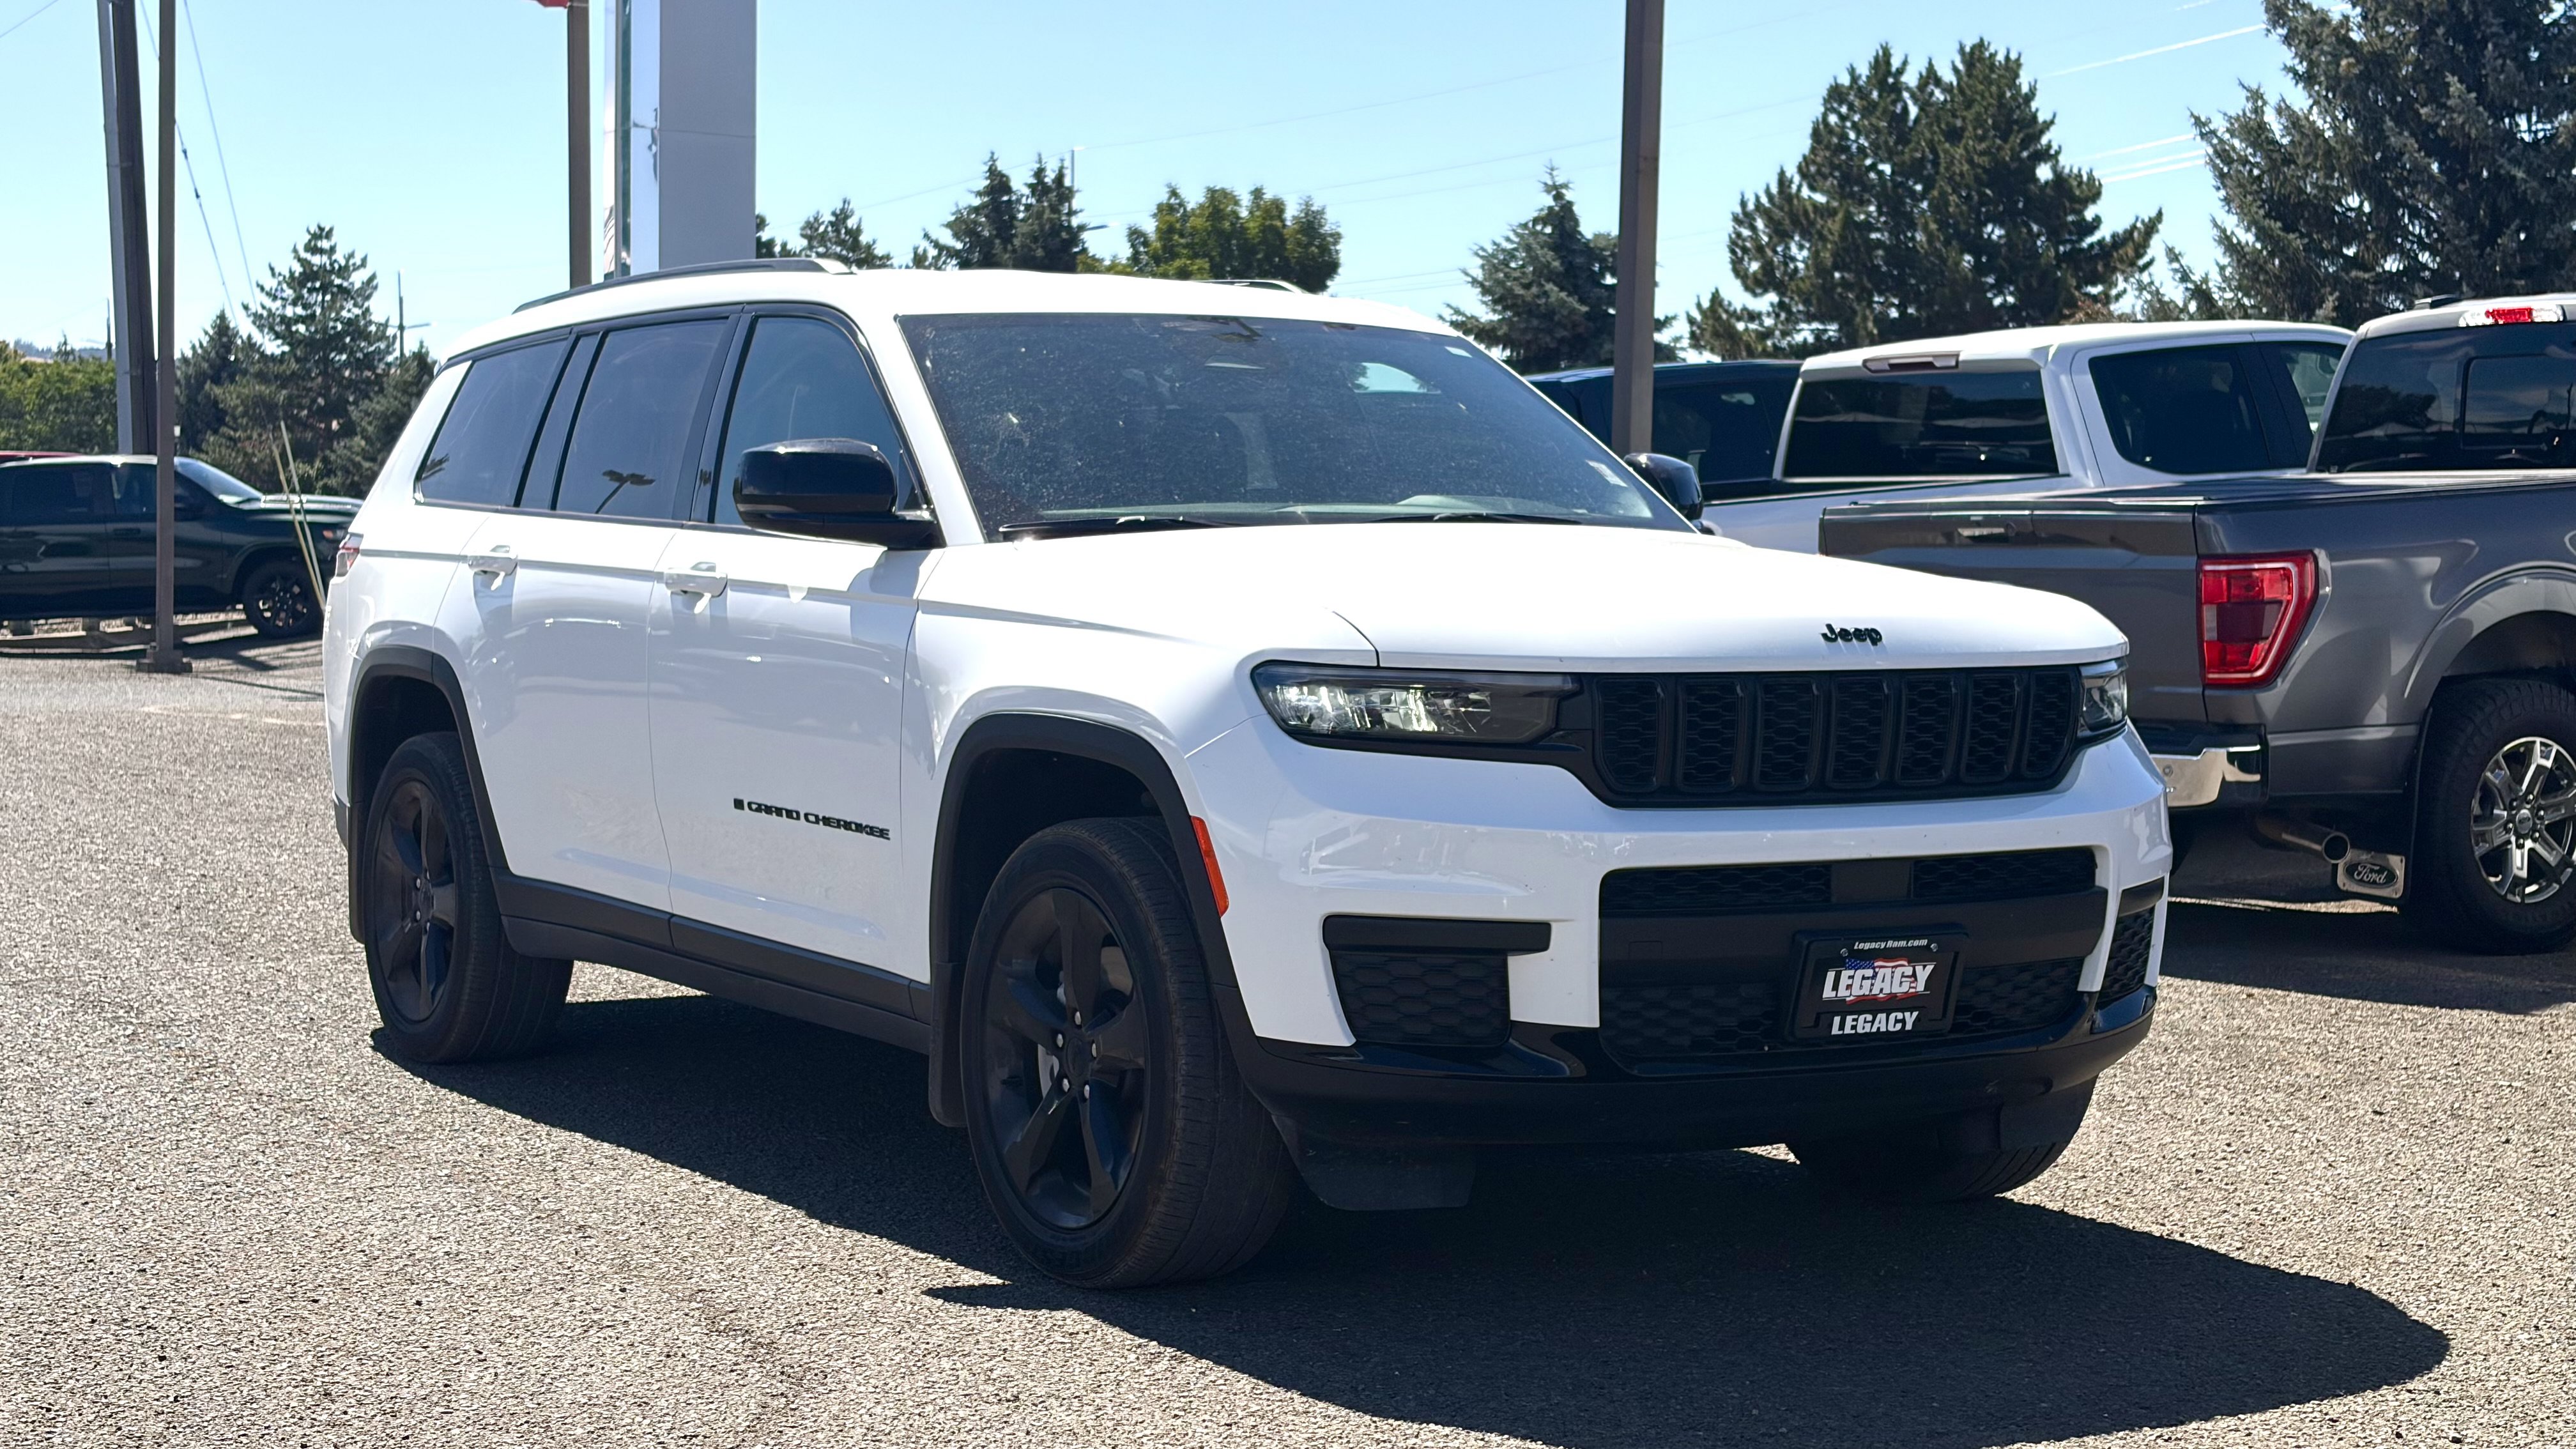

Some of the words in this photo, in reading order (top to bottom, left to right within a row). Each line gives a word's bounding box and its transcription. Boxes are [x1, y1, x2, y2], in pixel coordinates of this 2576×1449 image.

[1820, 623, 1882, 647] Jeep
[747, 801, 801, 820] GRAND
[804, 812, 891, 841] CHEROKEE
[2354, 863, 2388, 884] Ford
[1822, 965, 1935, 999] LEGACY
[1831, 1011, 1919, 1035] LEGACY
